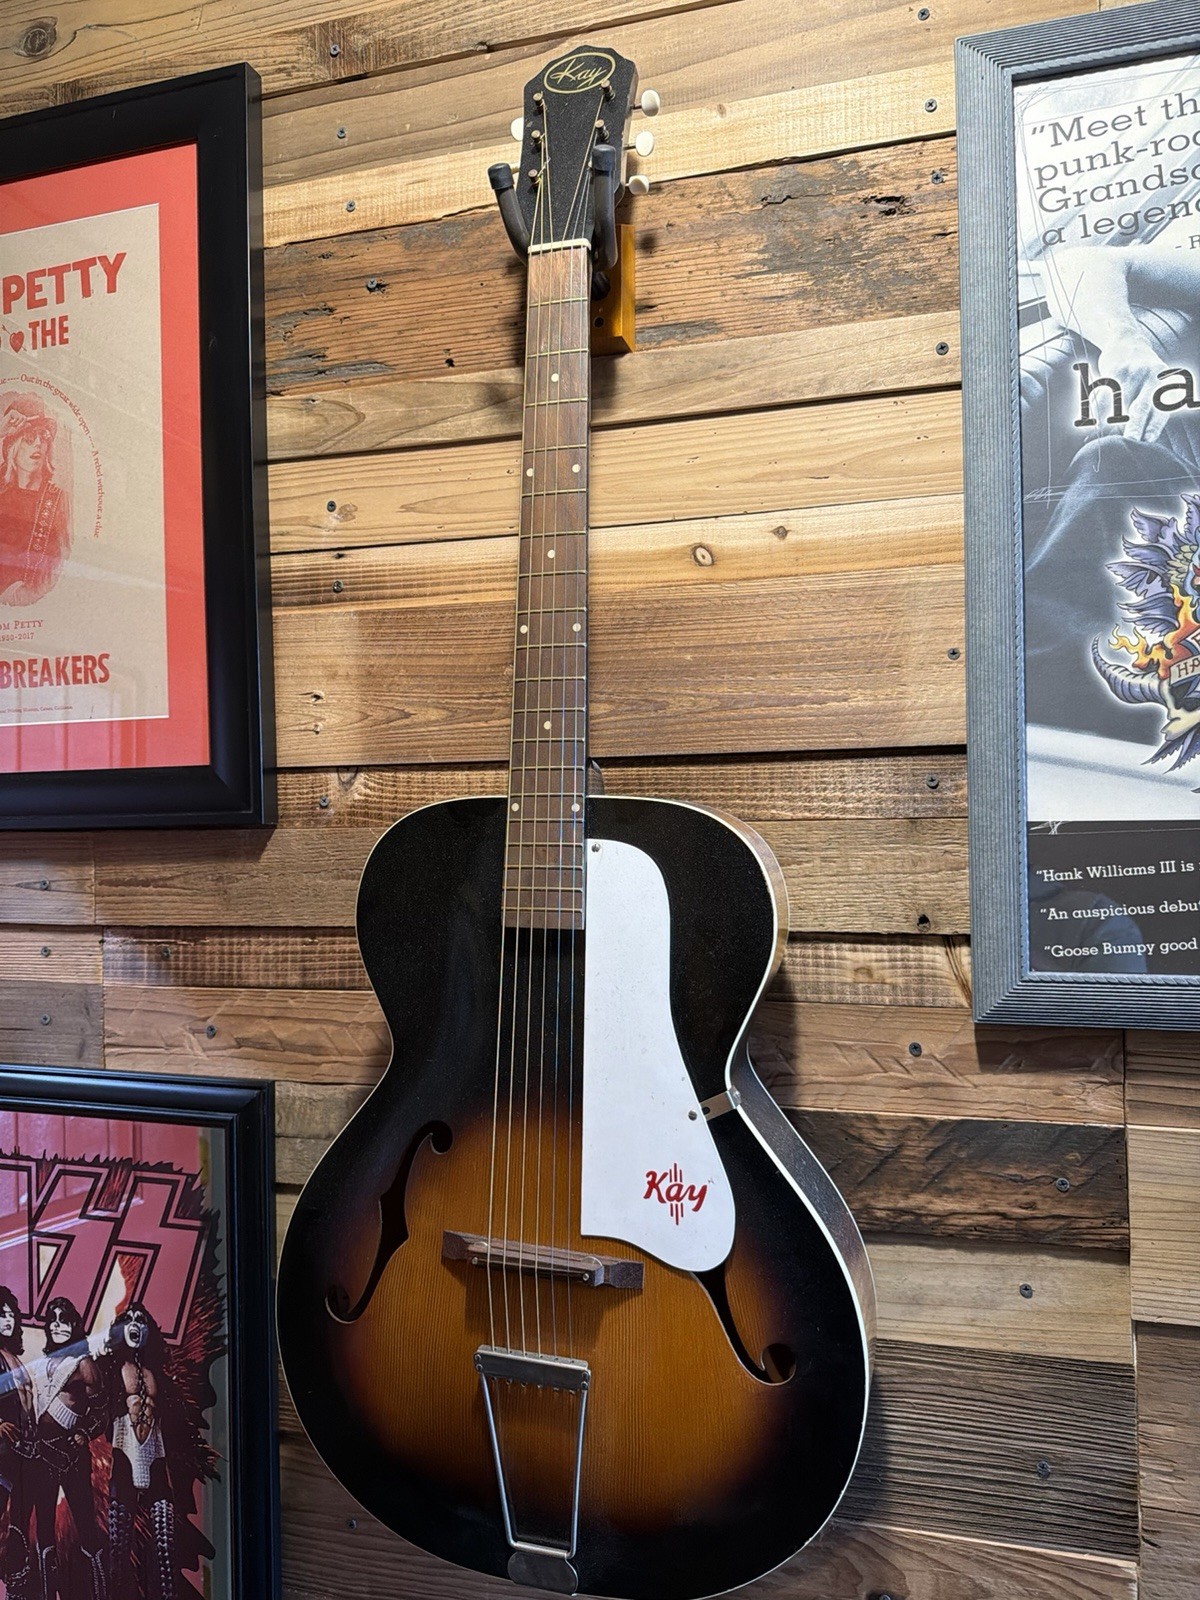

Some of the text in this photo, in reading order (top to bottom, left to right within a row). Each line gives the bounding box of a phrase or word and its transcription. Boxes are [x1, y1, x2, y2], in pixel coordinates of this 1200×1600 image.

[550, 58, 607, 88] Kay
[1161, 92, 1200, 121] th
[1042, 199, 1200, 247] a legen
[2, 252, 127, 315] PETTY
[28, 315, 69, 350] THE
[78, 416, 90, 435] open
[0, 653, 110, 689] BREAKERS
[1086, 865, 1156, 878] Williams
[1159, 860, 1177, 874] III
[1180, 860, 1195, 872] is
[1072, 904, 1155, 920] auspicious
[1102, 942, 1156, 956] Bumpy
[1159, 938, 1198, 954] good
[643, 1170, 708, 1212] Kay
